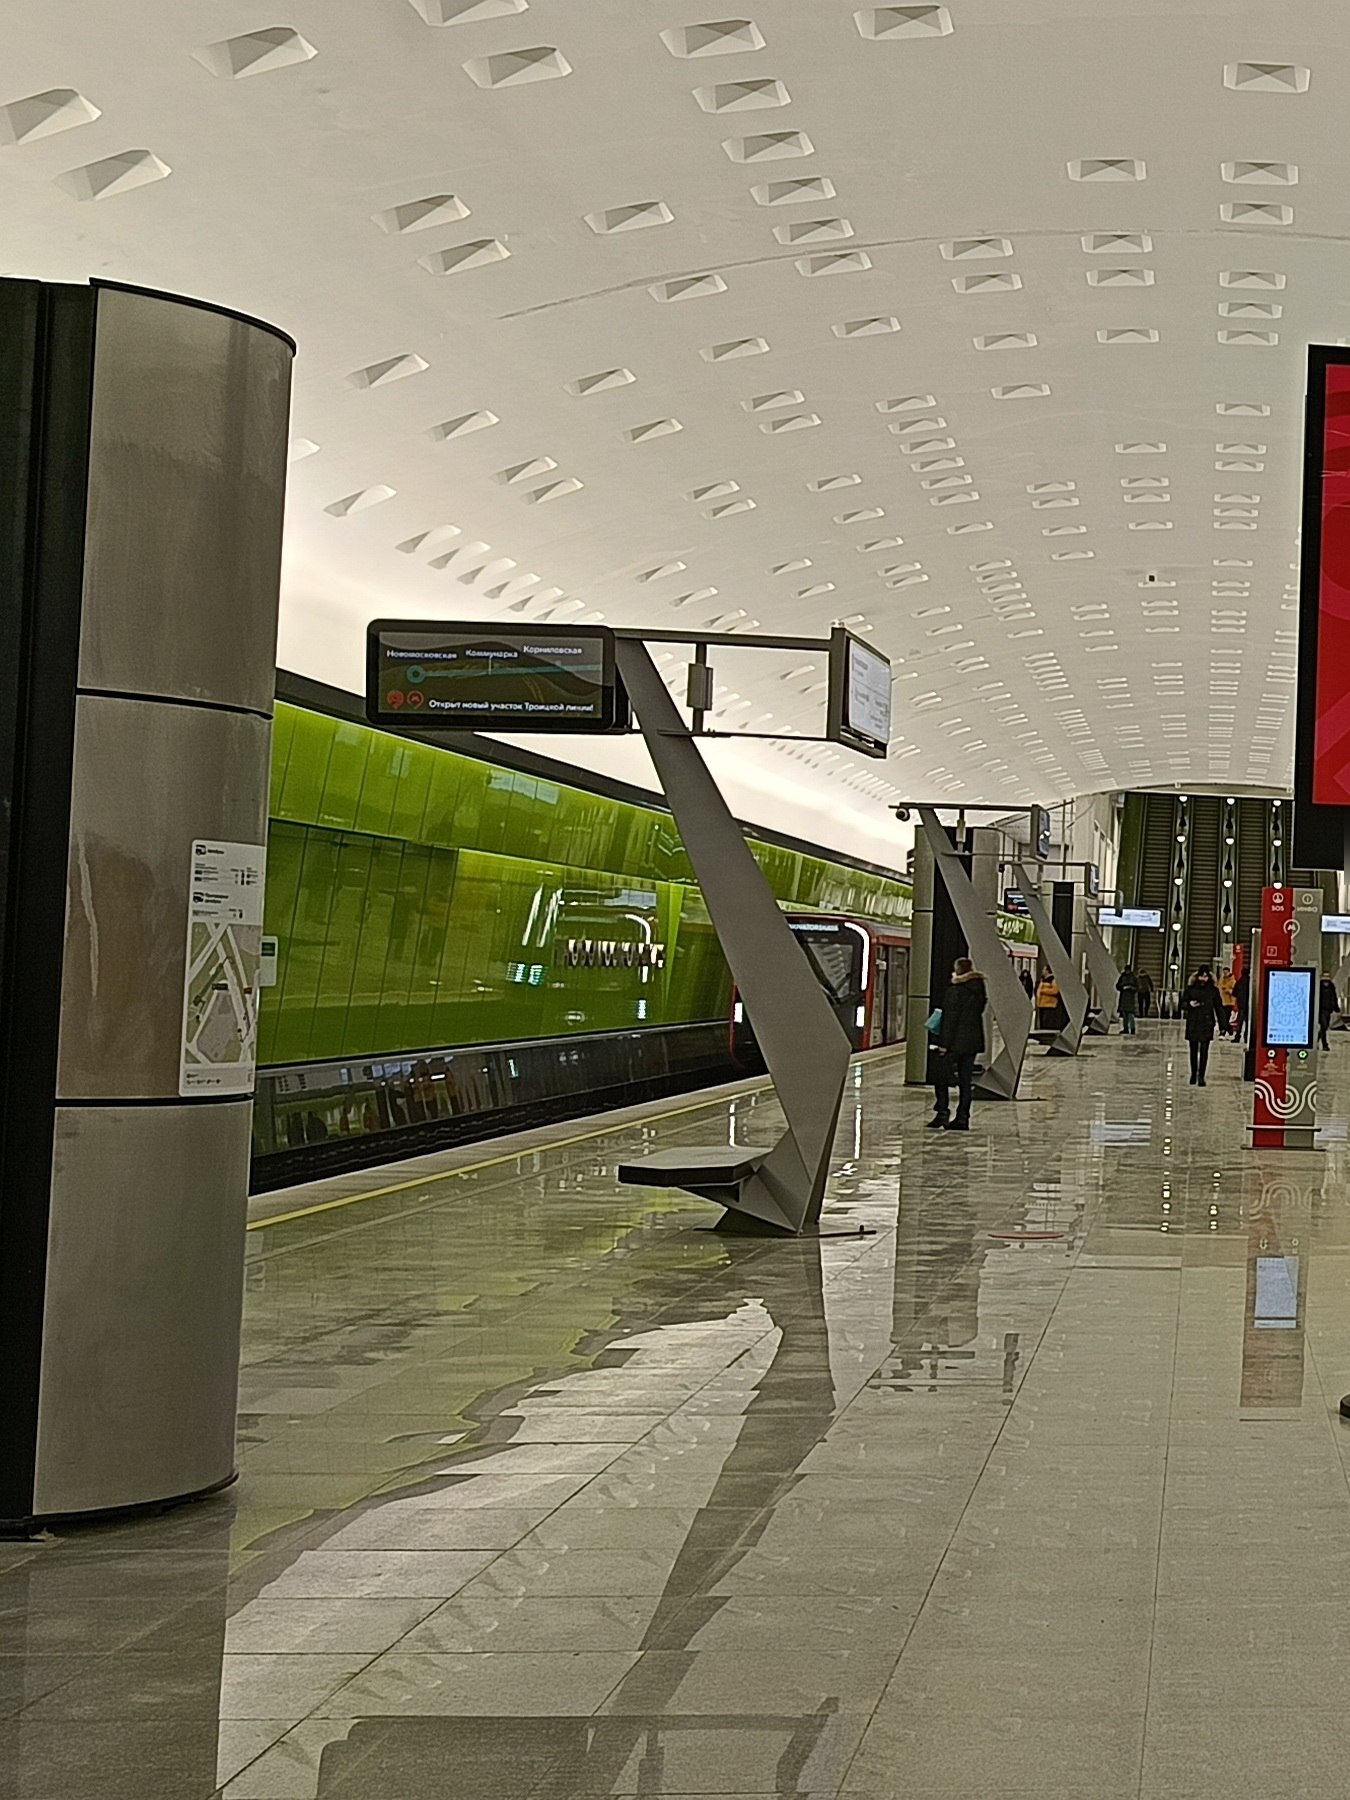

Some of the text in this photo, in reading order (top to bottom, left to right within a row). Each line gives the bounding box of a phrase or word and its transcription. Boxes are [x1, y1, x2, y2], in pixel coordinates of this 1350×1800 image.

[387, 649, 457, 659] Новомосковская
[466, 648, 519, 659] Коммунарка
[523, 645, 582, 655] Корниловская
[428, 699, 594, 712] Открыт новый участок Троицкой линии!
